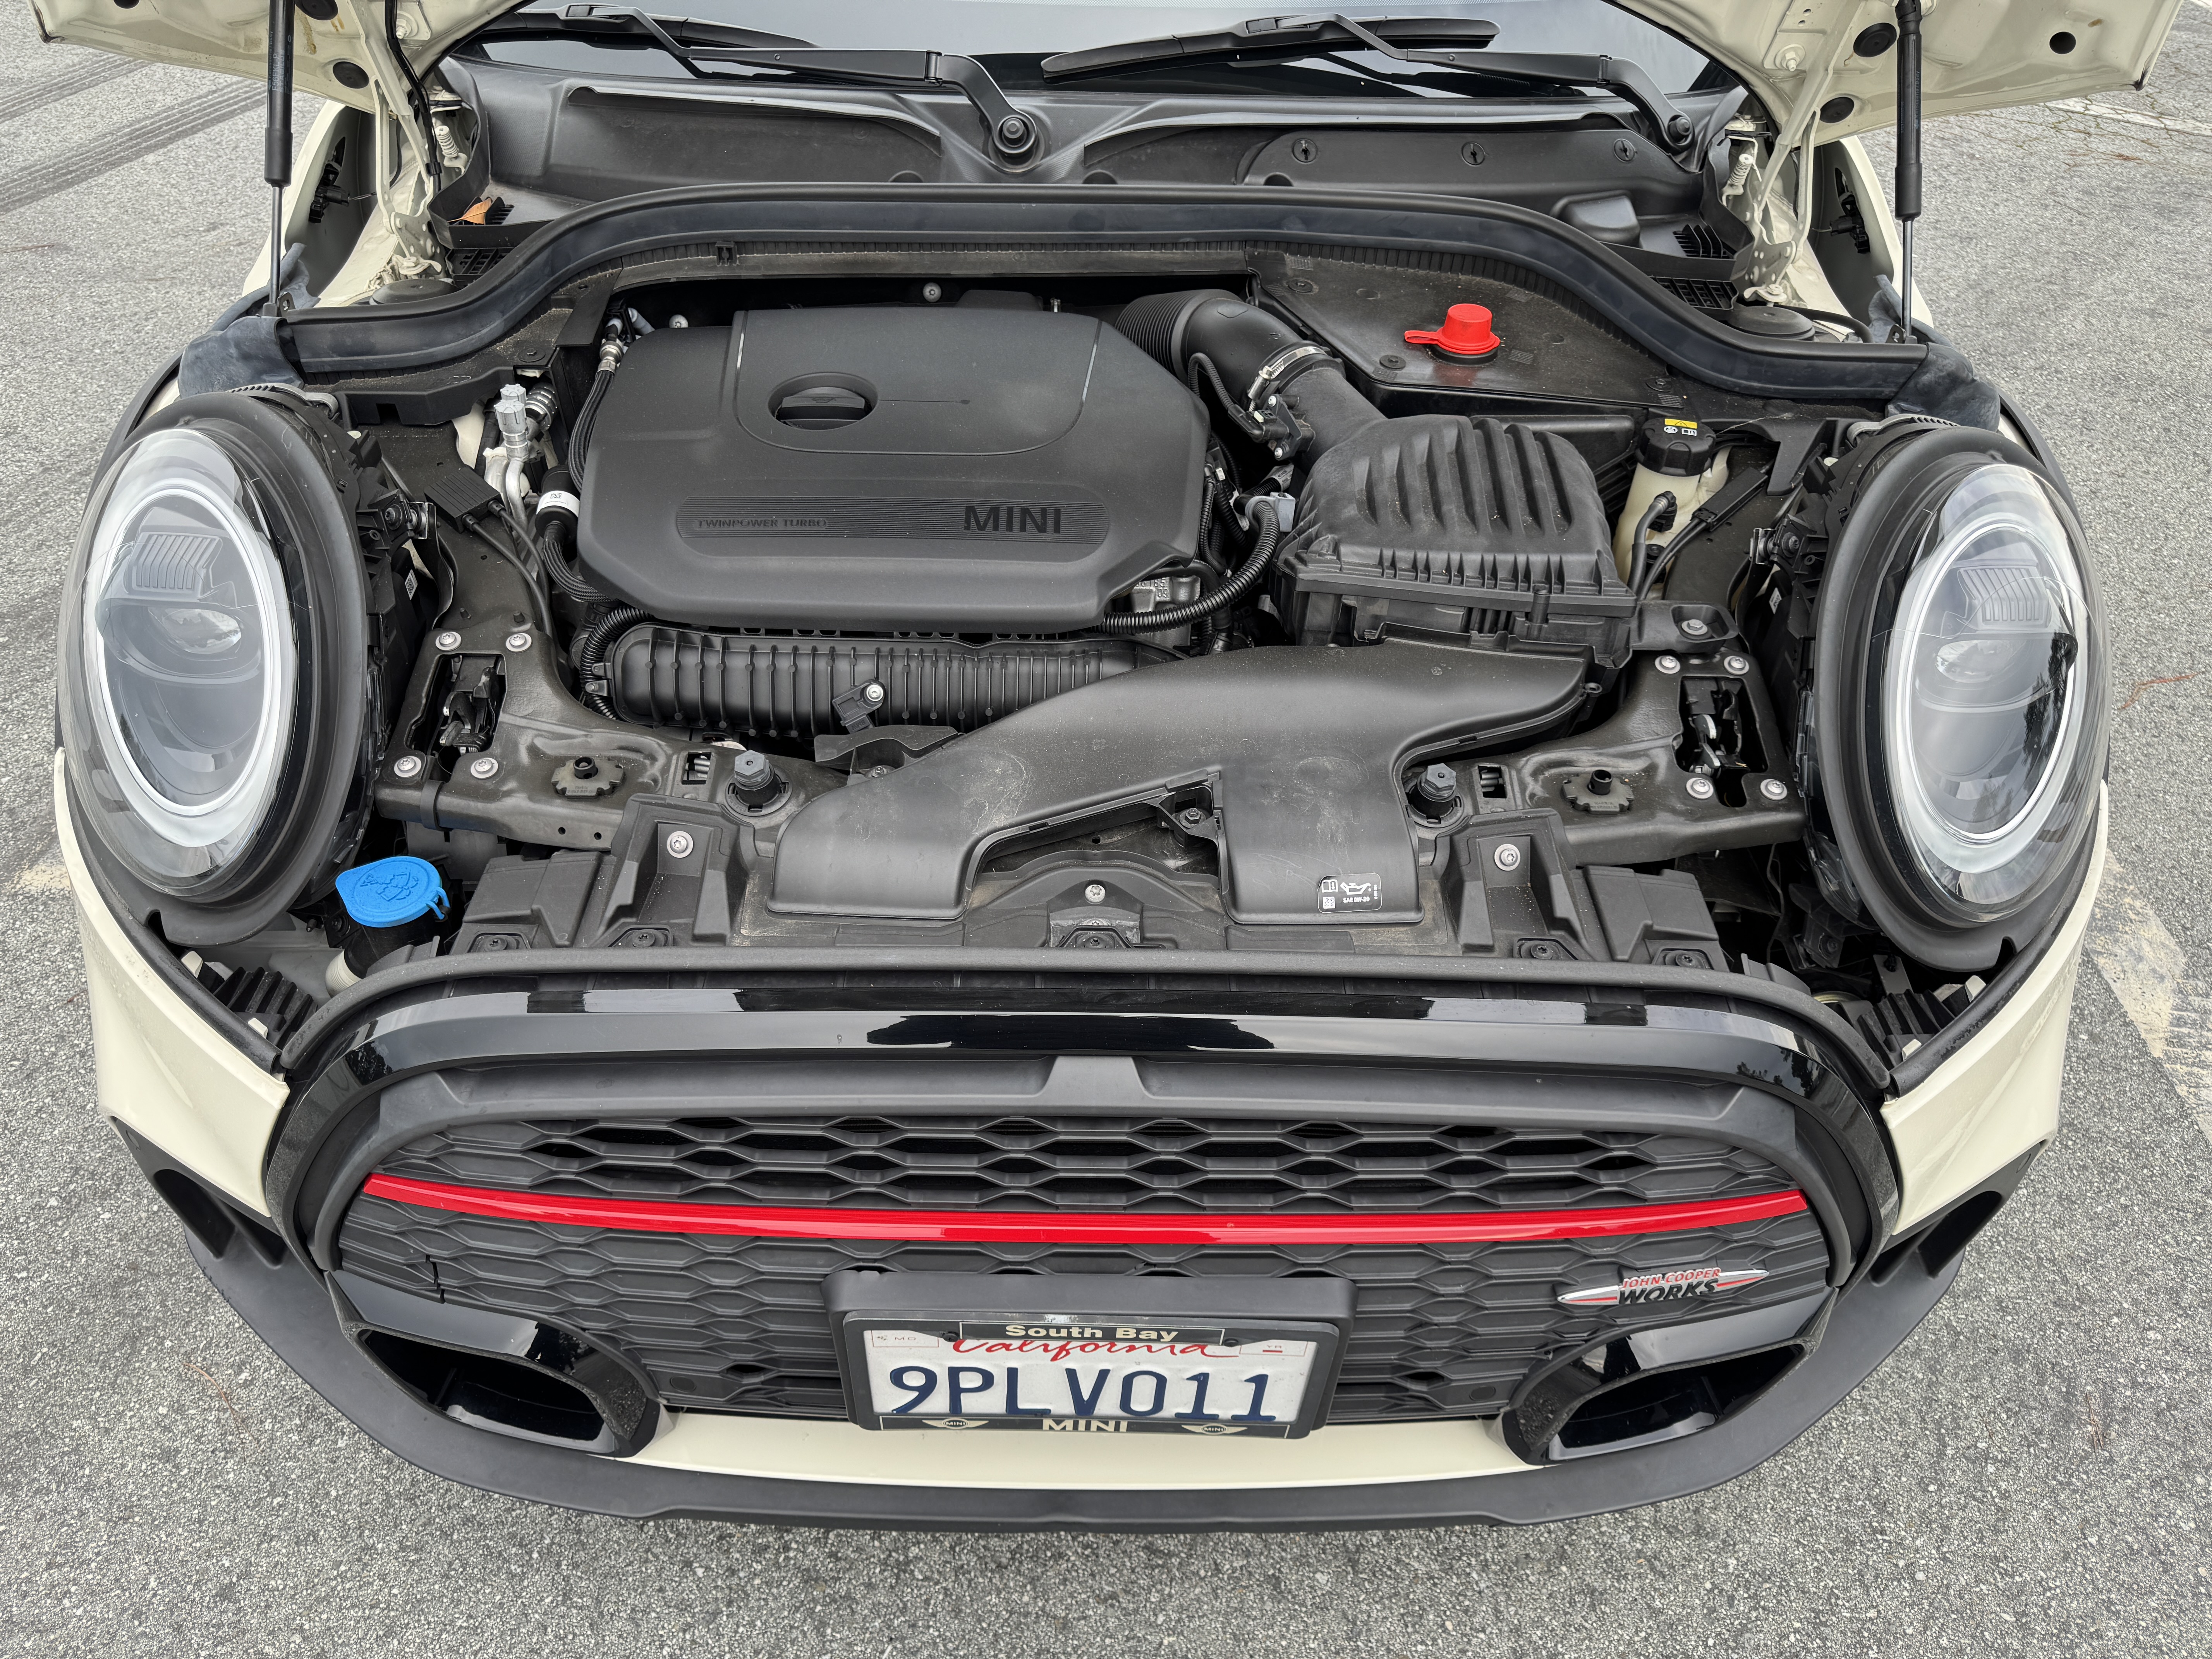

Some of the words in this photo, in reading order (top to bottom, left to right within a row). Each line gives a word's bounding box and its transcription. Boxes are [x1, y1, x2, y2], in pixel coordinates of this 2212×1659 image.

[698, 519, 778, 527] TWINPOWER
[782, 519, 827, 527] TURBO
[964, 505, 1061, 534] MINI
[1621, 1274, 1662, 1289] JOHN
[1665, 1267, 1721, 1284] COOPER
[1619, 1278, 1719, 1305] WORKS
[1005, 1325, 1103, 1338] South
[1115, 1328, 1179, 1342] Bay
[952, 1339, 1239, 1362] California
[889, 1365, 1276, 1421] 9PLV011
[1042, 1419, 1128, 1432] MINI
